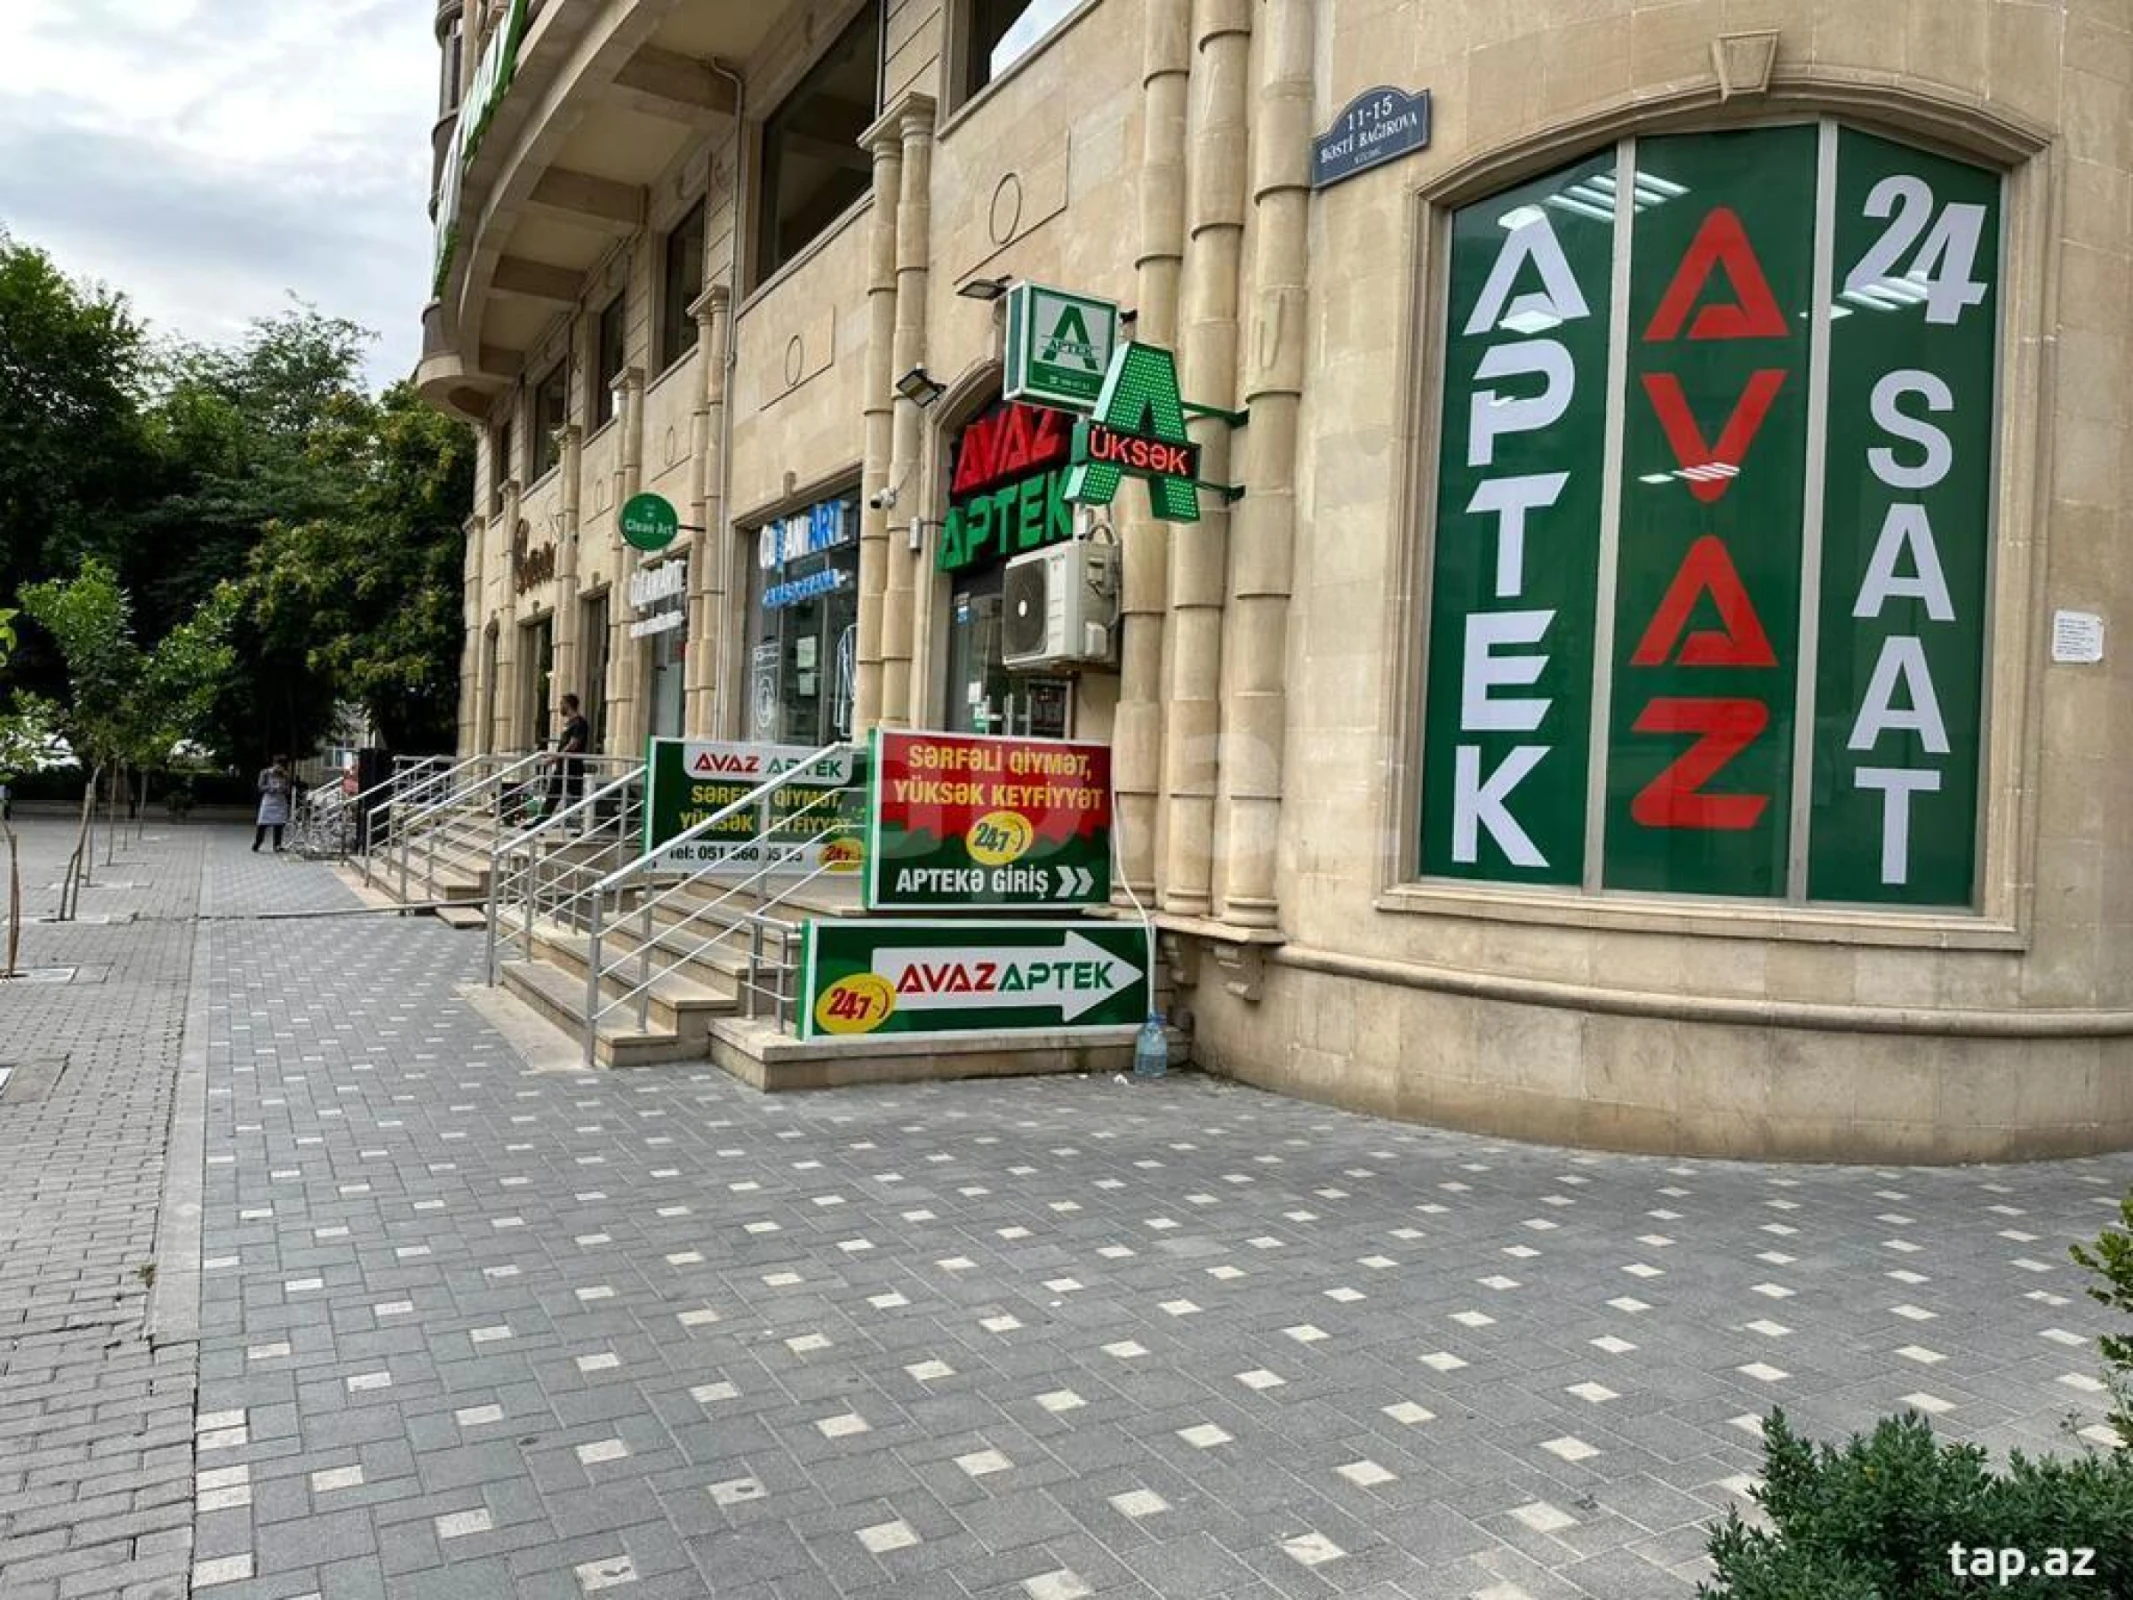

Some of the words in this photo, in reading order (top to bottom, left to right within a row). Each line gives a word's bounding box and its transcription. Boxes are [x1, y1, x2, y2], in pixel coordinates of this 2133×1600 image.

[1348, 93, 1393, 131] 11-15
[1844, 174, 1988, 325] 24
[952, 402, 1060, 494] AVAZ
[1090, 424, 1189, 475] ÜKSƏK
[937, 462, 1074, 572] APTEK
[1451, 203, 1591, 868] APTEK
[1628, 205, 1791, 831] AVAZ
[1846, 369, 1957, 885] SAAT
[694, 753, 760, 772] AVAZ
[893, 774, 985, 805] YÜKSƏK
[991, 781, 1104, 810] KEYFİYYƏT
[909, 744, 1001, 772] SƏRFƏLİ
[1010, 747, 1092, 781] QİYMƏT,
[896, 867, 984, 893] APTEKƏ
[991, 864, 1049, 900] GİRİŞ
